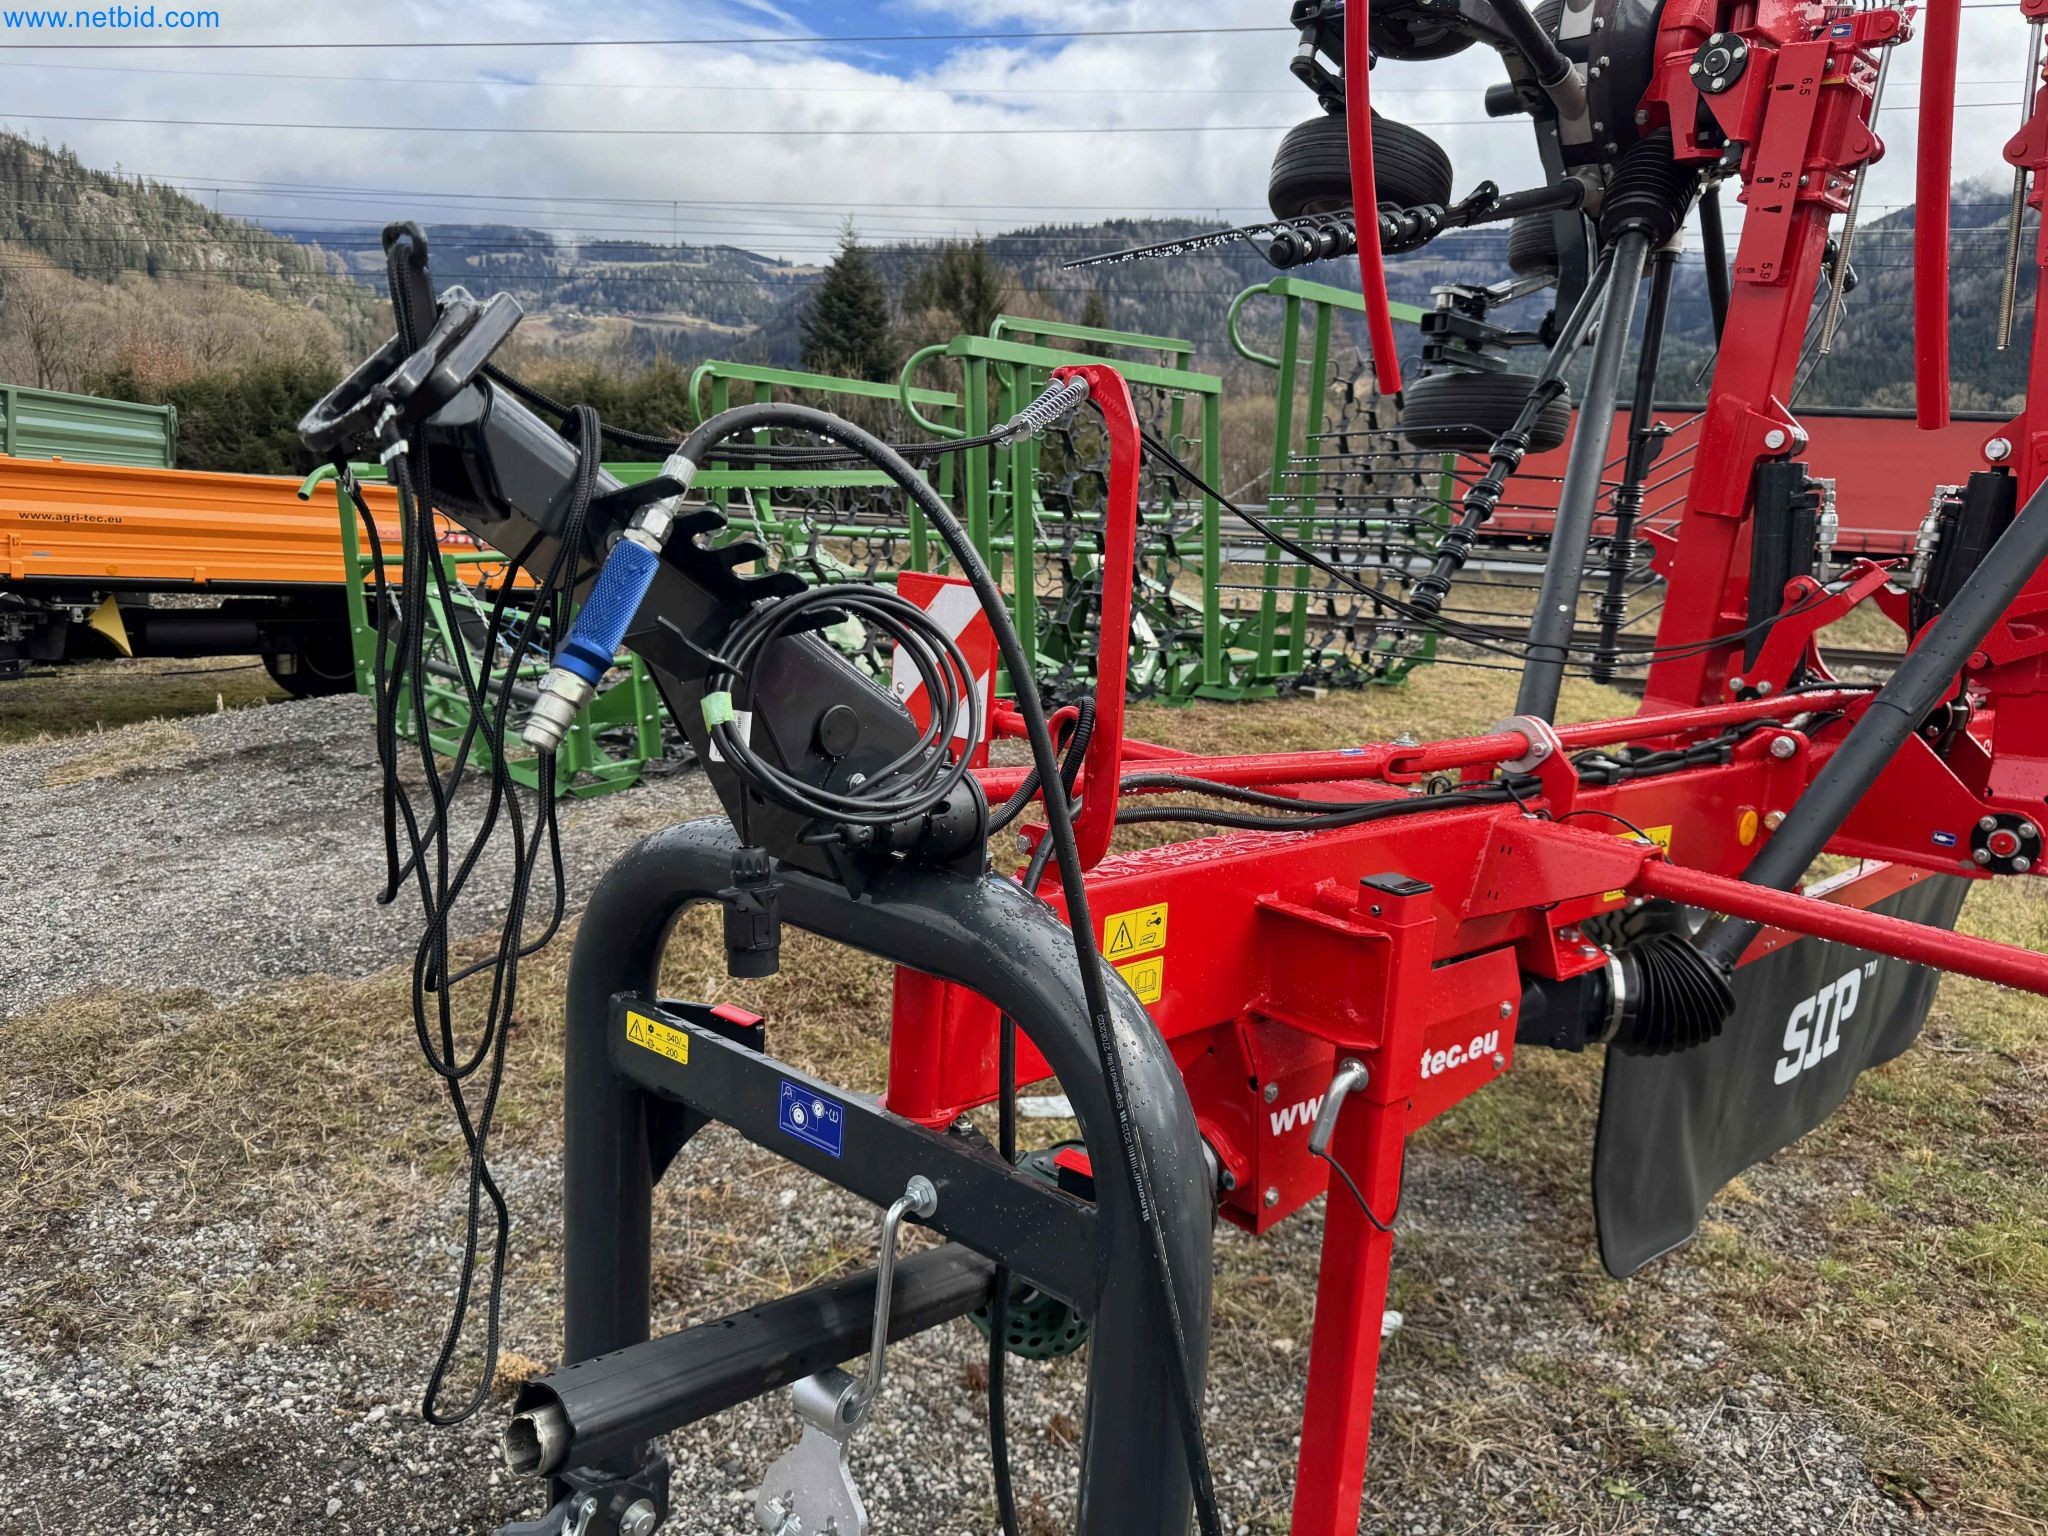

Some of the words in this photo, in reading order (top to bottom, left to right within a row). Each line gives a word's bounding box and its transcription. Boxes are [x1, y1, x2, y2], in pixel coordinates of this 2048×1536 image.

[1799, 77, 1814, 96] 6.5
[1779, 171, 1793, 189] 6.2
[1760, 262, 1773, 279] 5.9
[19, 512, 122, 523] www.agri-tec.eu
[1774, 968, 1861, 1085] SIP
[666, 1047, 678, 1059] 200
